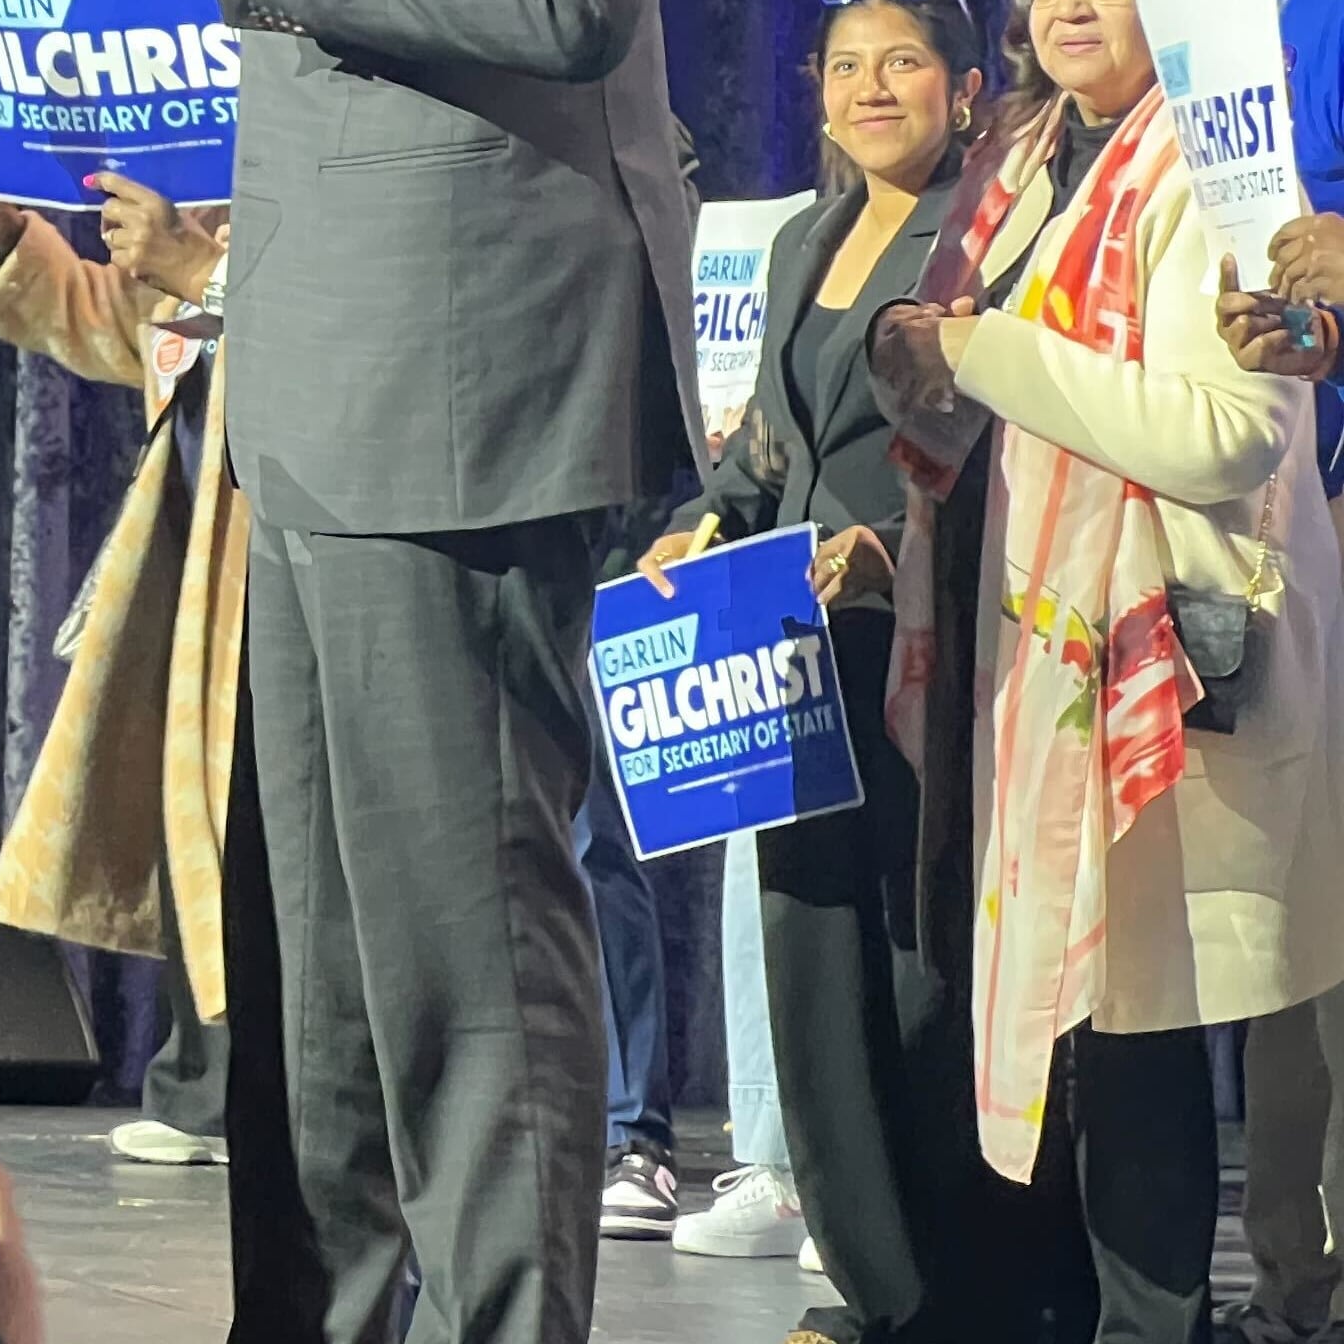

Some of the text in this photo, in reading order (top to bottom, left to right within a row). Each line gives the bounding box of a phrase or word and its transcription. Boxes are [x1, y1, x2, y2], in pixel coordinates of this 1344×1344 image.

[18, 102, 152, 133] SECRETARY
[162, 100, 205, 128] OF
[1247, 166, 1286, 198] STATE
[697, 254, 756, 282] GARLIN
[694, 292, 768, 343] GILCH
[600, 628, 688, 677] GARLIN
[609, 635, 824, 748] GILCHRIST
[625, 753, 654, 778] FOR
[662, 729, 750, 773] SECRETARY
[756, 719, 779, 748] OF
[783, 704, 835, 742] STATE
